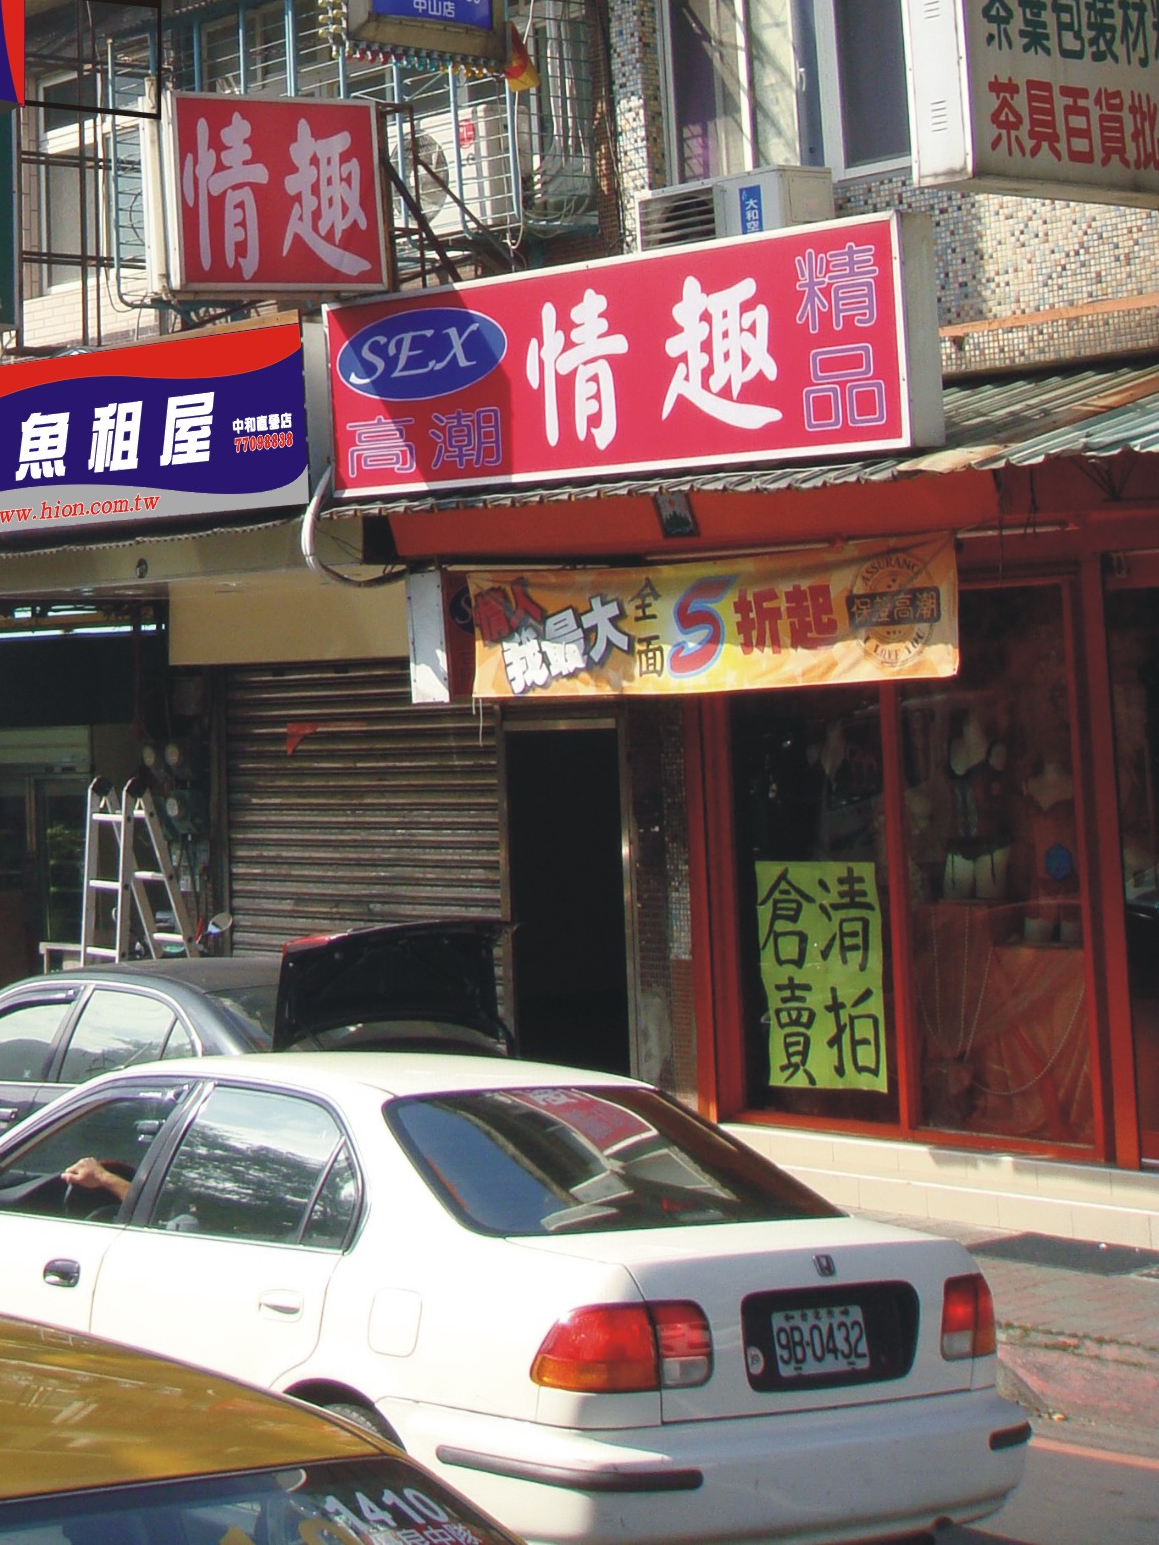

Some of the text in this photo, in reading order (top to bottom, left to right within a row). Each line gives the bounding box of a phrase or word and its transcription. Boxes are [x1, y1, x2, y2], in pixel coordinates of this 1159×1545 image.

[988, 74, 1159, 171] 茶具百貨批
[182, 111, 372, 281] 情趣
[348, 321, 480, 387] SEX
[526, 275, 783, 451] 情趣
[795, 241, 886, 432] 精品
[232, 412, 293, 435] 中和直營店
[234, 431, 294, 454] 77098838
[346, 406, 503, 479] 高潮
[861, 556, 923, 586] ASSURANC
[629, 576, 664, 679] 全面
[324, 1488, 448, 1534] 1410
